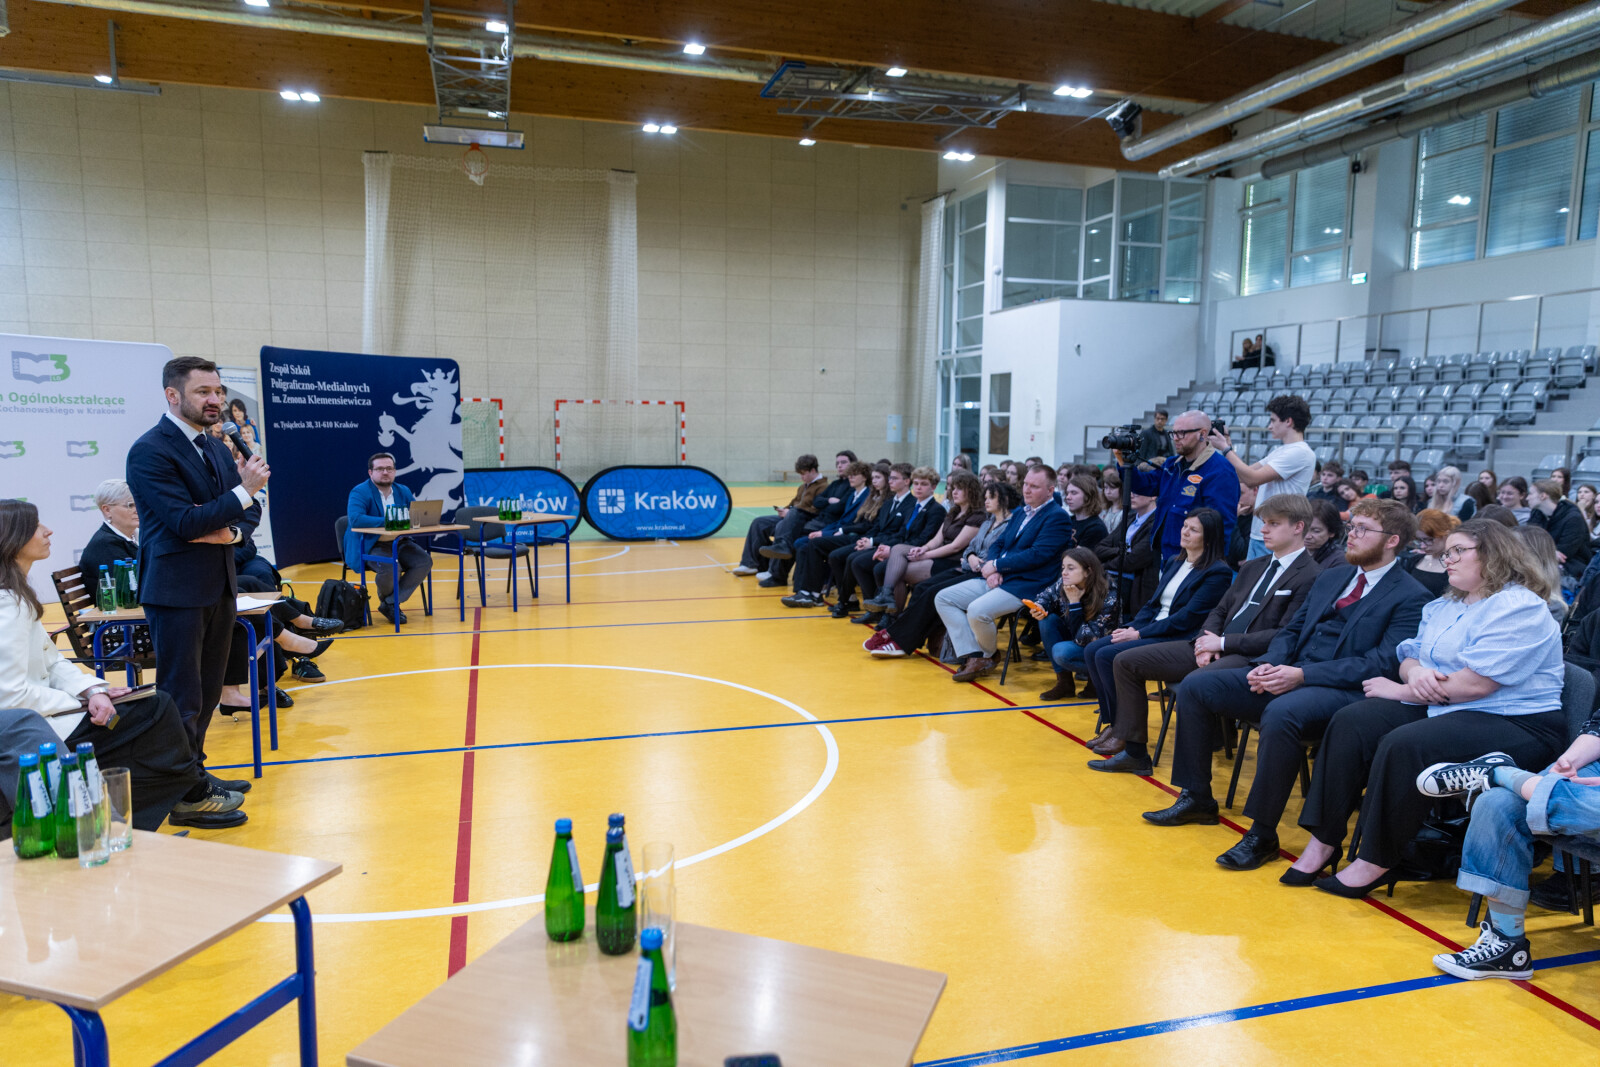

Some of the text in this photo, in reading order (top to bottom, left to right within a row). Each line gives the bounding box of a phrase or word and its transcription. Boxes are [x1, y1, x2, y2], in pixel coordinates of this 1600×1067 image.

[269, 362, 311, 376] Zespół Szkół
[271, 378, 370, 394] Poligraficzno-Medialnych
[8, 392, 125, 407] Ogólnokształcące
[272, 393, 372, 405] im. Zenona Klemensiewicza
[0, 405, 75, 415] ochanowskiego
[86, 407, 126, 415] Krakowie
[634, 489, 718, 511] Kraków
[635, 523, 686, 533] www.krakow.pl
